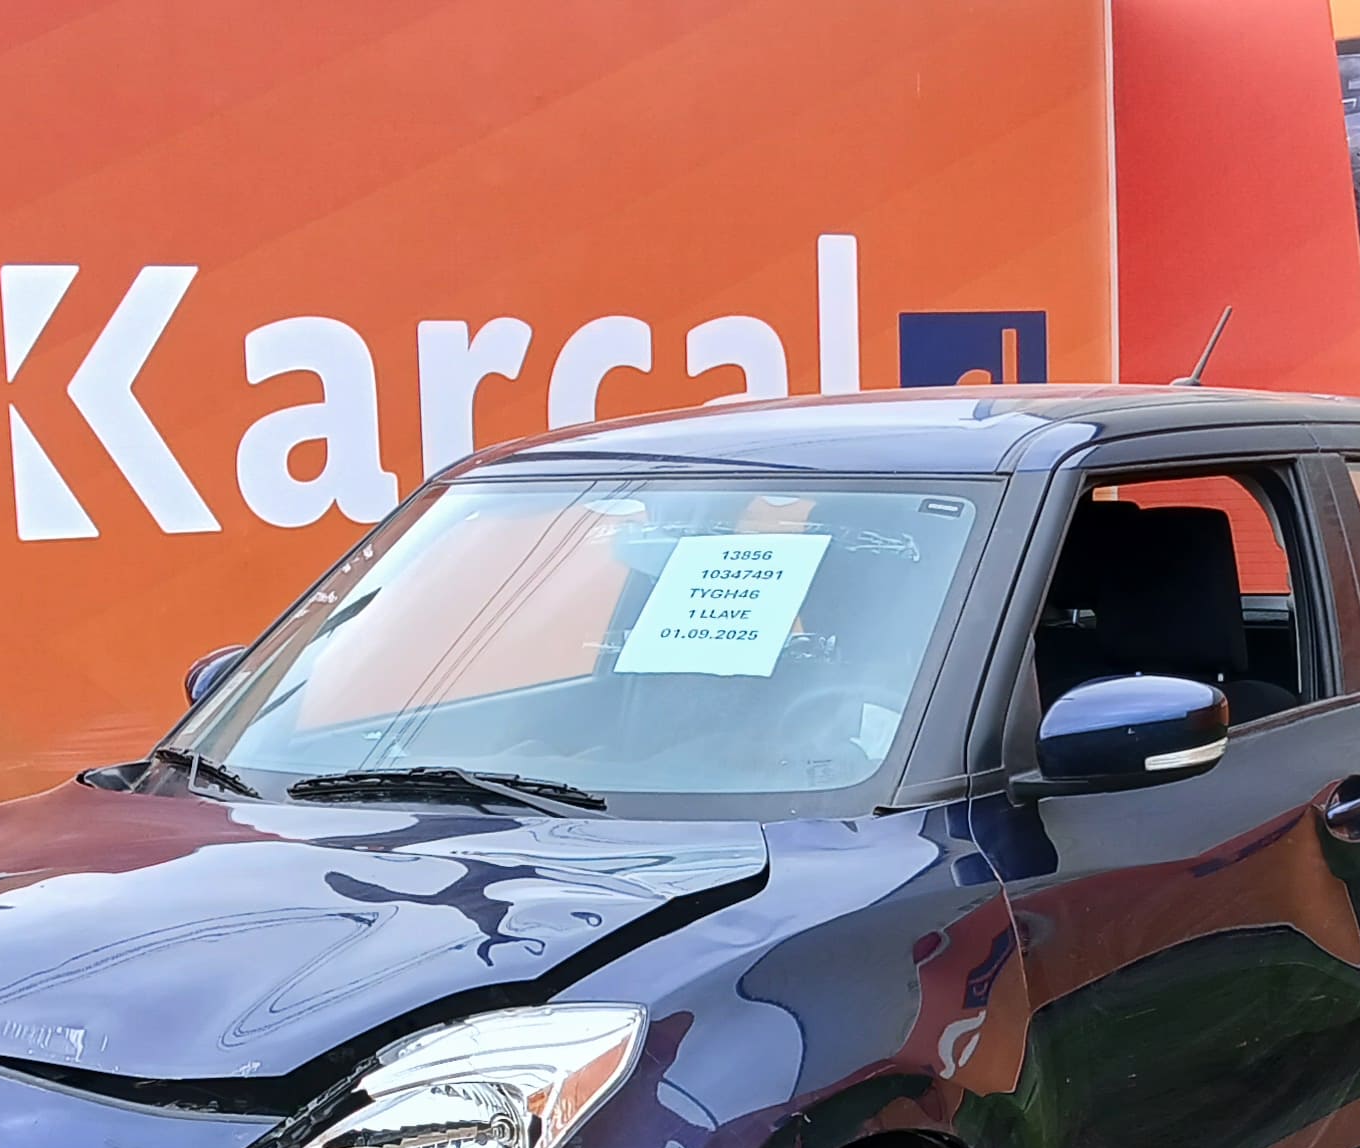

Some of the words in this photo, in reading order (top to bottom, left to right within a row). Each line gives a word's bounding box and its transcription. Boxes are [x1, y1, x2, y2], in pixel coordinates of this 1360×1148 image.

[722, 550, 773, 561] 13856
[701, 569, 783, 580] 10347491
[689, 588, 761, 600] TYGH46
[688, 609, 696, 619] 1
[700, 609, 752, 620] LLAVE
[660, 628, 759, 641] 01.09.2025
